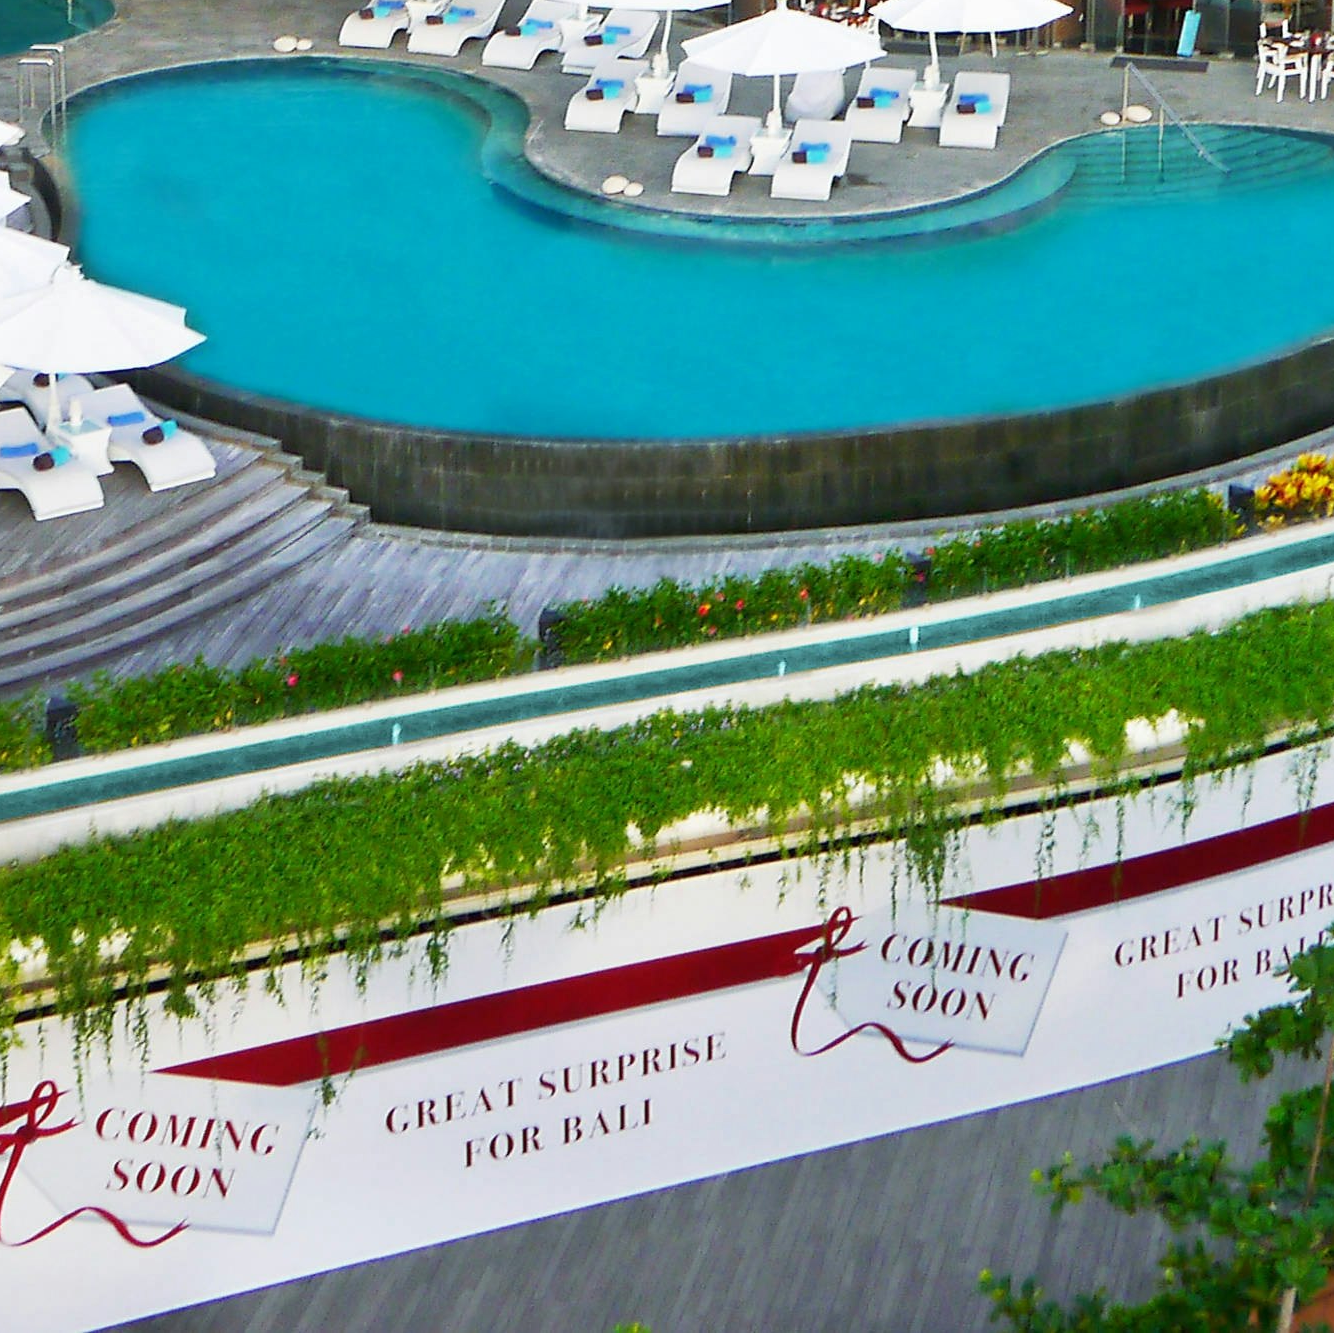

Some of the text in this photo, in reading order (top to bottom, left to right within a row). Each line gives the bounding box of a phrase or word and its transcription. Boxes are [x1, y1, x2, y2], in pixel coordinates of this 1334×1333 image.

[881, 933, 1035, 982] COMING
[1114, 914, 1227, 967] GREAT
[887, 979, 997, 1021] SOON
[1175, 958, 1240, 999] FOR
[385, 1031, 727, 1135] GREAT SURPRISE
[95, 1107, 280, 1156] COMING
[464, 1098, 654, 1168] FOR BALI
[105, 1158, 236, 1199] SOON
